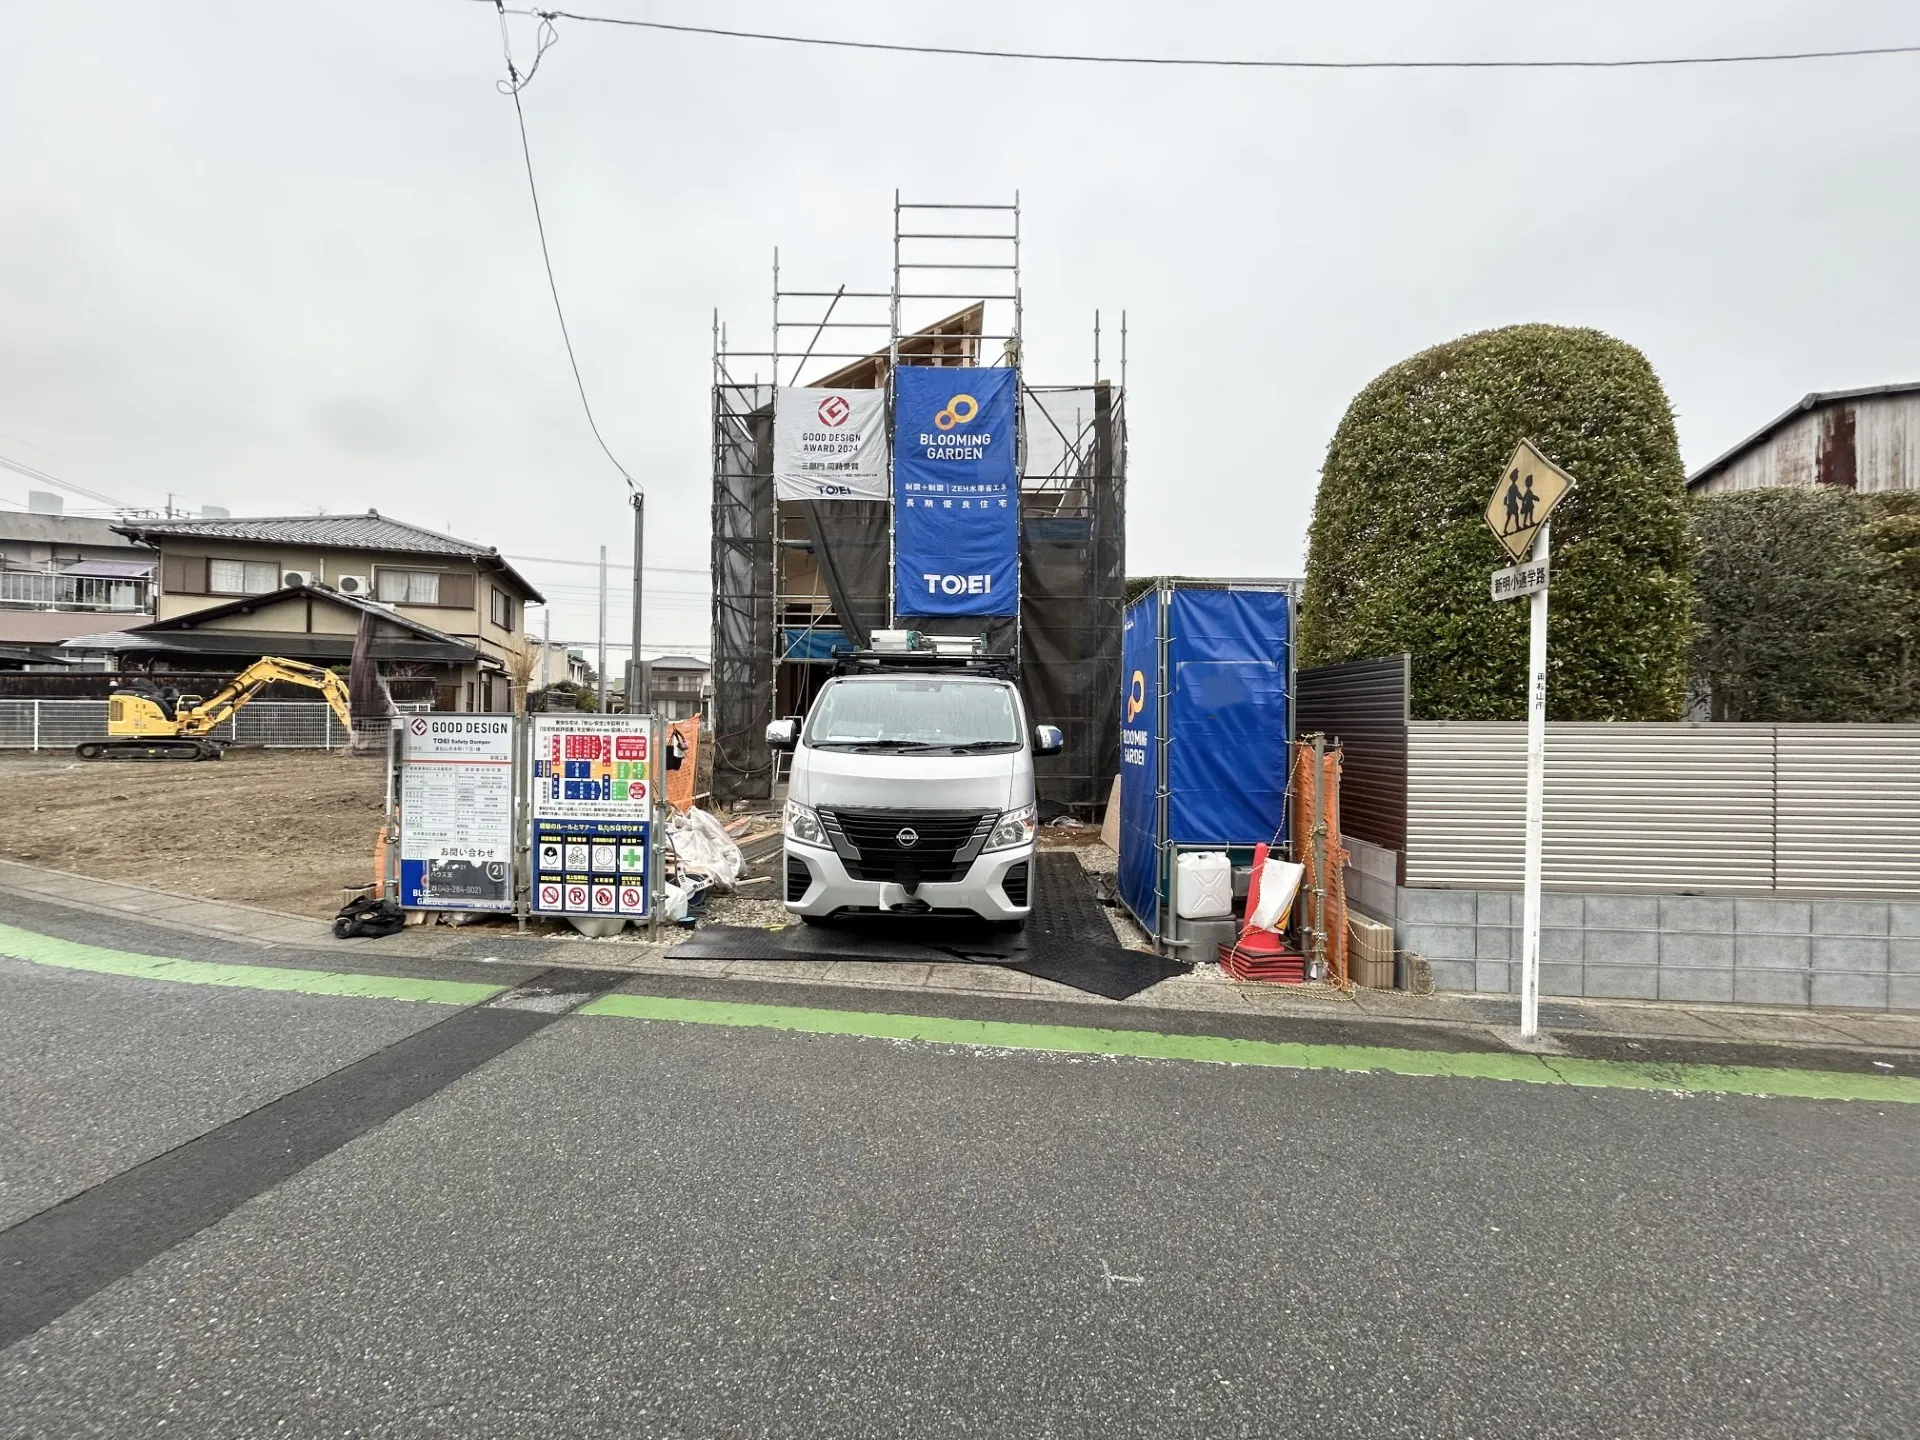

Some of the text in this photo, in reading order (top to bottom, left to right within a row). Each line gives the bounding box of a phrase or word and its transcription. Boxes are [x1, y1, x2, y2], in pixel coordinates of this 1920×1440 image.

[802, 432, 861, 442] GOOD DESIGN
[920, 433, 991, 446] BLOOMING
[803, 444, 858, 453] AWARD 2024
[927, 447, 983, 460] GARDEN
[923, 573, 991, 595] TOEI
[1494, 566, 1546, 593] 新明小通学路
[432, 721, 508, 734] GOOD DESIGN
[441, 847, 495, 858] お問い合わせ
